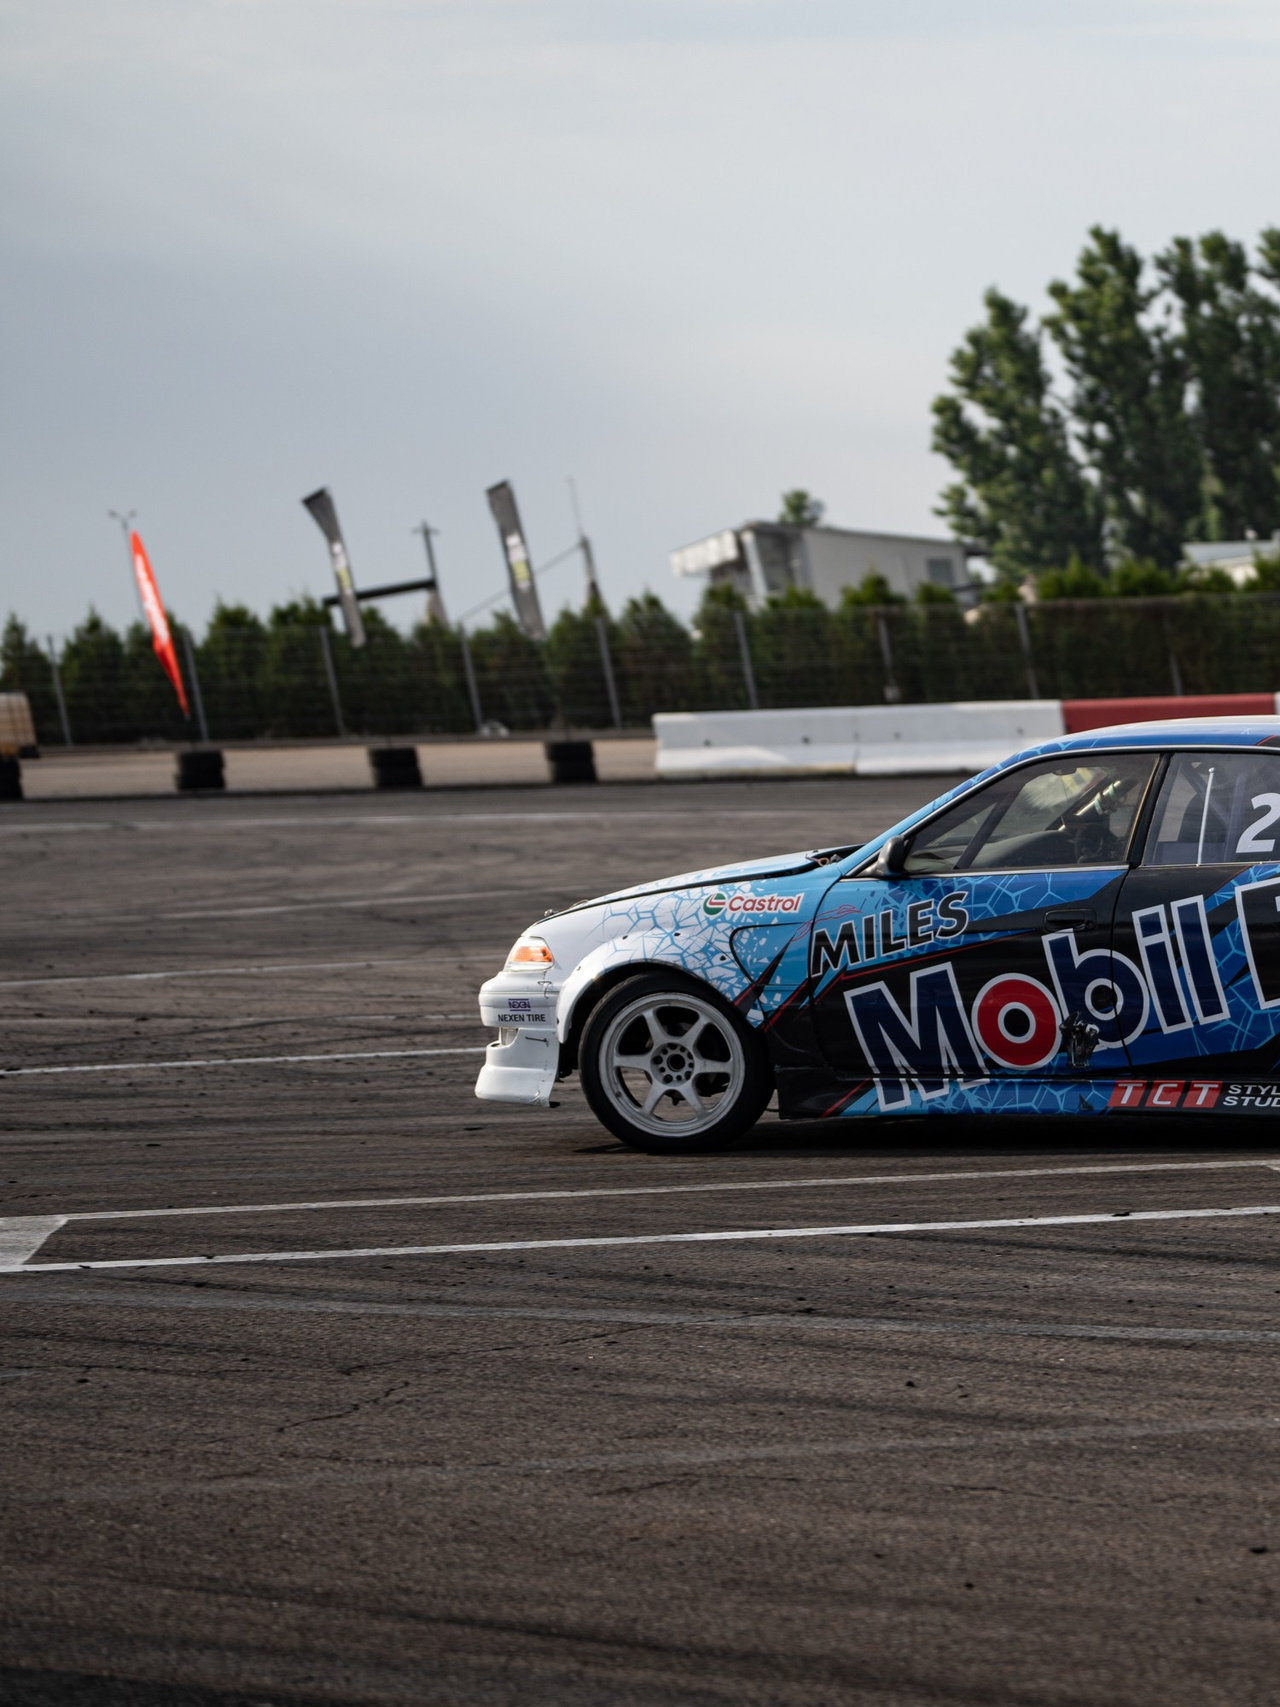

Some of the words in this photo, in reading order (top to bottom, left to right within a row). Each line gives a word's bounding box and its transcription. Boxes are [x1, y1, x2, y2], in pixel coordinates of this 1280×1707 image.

[728, 892, 804, 914] Castrol
[810, 890, 969, 978] MILES
[843, 894, 1231, 1112] Mobil
[497, 1014, 525, 1022] NEXEN
[526, 1013, 546, 1022] TIRE
[1118, 1083, 1218, 1105] TCT
